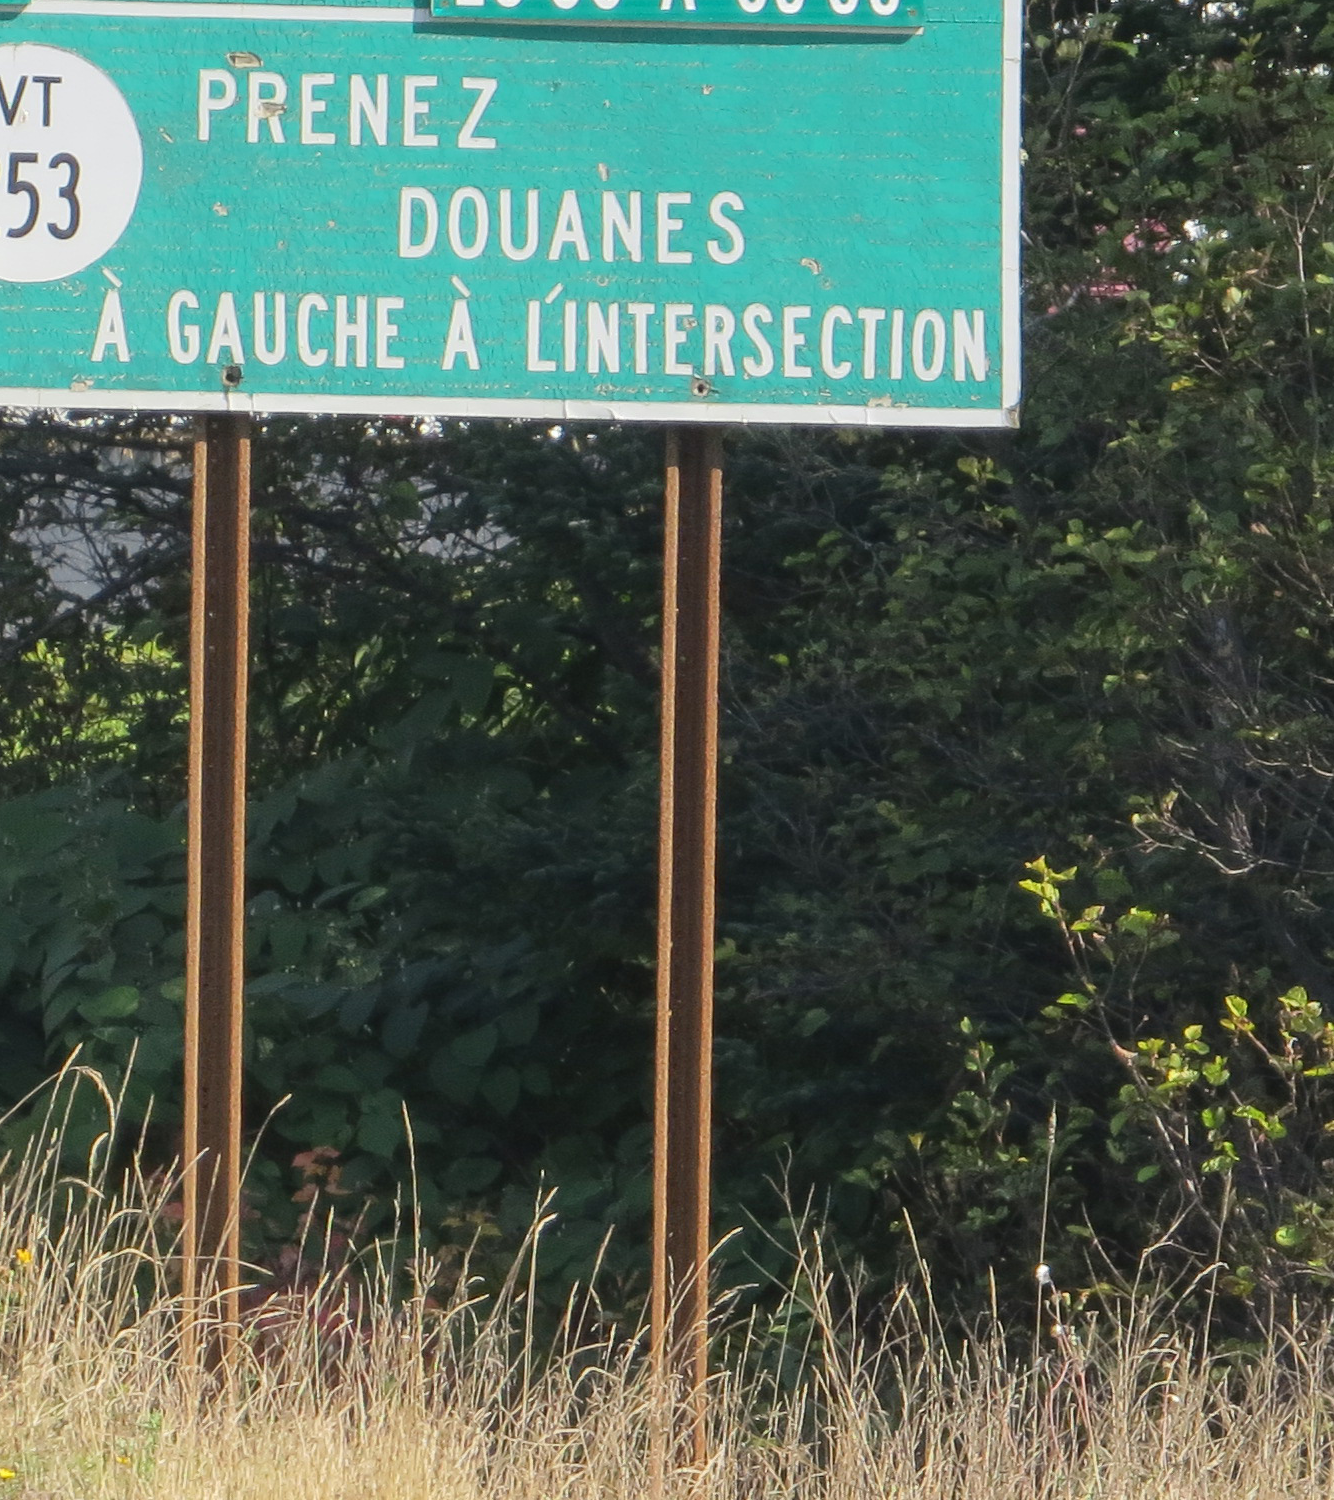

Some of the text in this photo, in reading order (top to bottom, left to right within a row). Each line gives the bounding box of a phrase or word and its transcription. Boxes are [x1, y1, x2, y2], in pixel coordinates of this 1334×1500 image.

[197, 68, 499, 150] PRENEZ
[398, 186, 746, 264] DOUANES
[92, 268, 130, 363] À
[168, 289, 406, 369] GAUCHE
[442, 275, 480, 371] À
